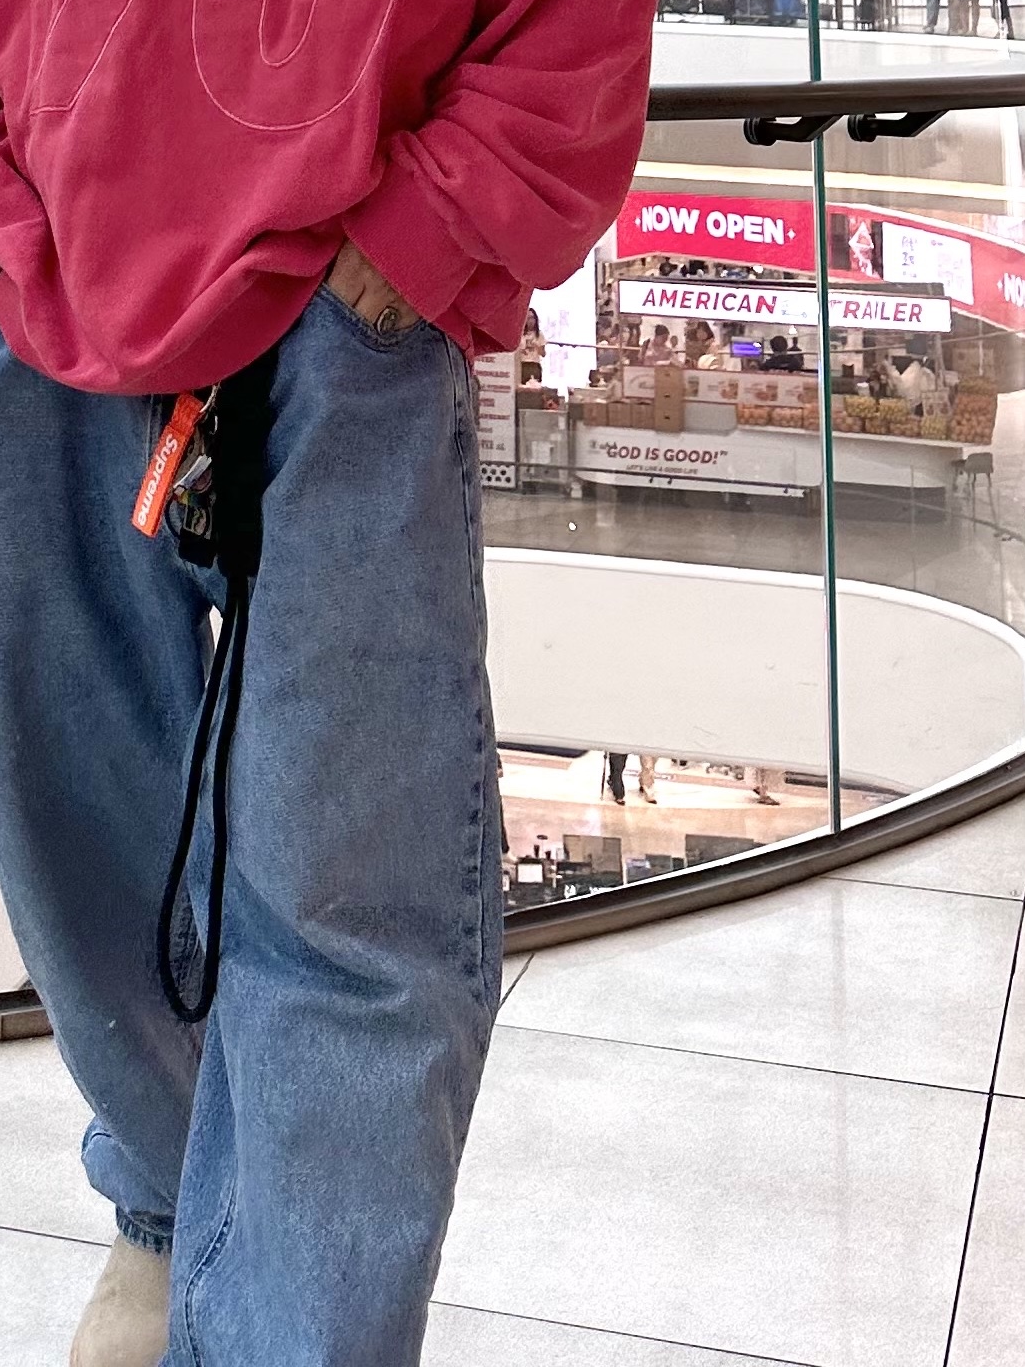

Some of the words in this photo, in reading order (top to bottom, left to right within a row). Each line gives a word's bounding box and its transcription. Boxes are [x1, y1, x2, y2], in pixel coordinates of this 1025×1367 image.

[641, 205, 700, 235] NOW
[706, 211, 786, 245] OPEN
[642, 288, 777, 314] AMERICAN
[1003, 272, 1025, 308] NO
[644, 446, 659, 461] IS
[137, 434, 178, 526] Supreme
